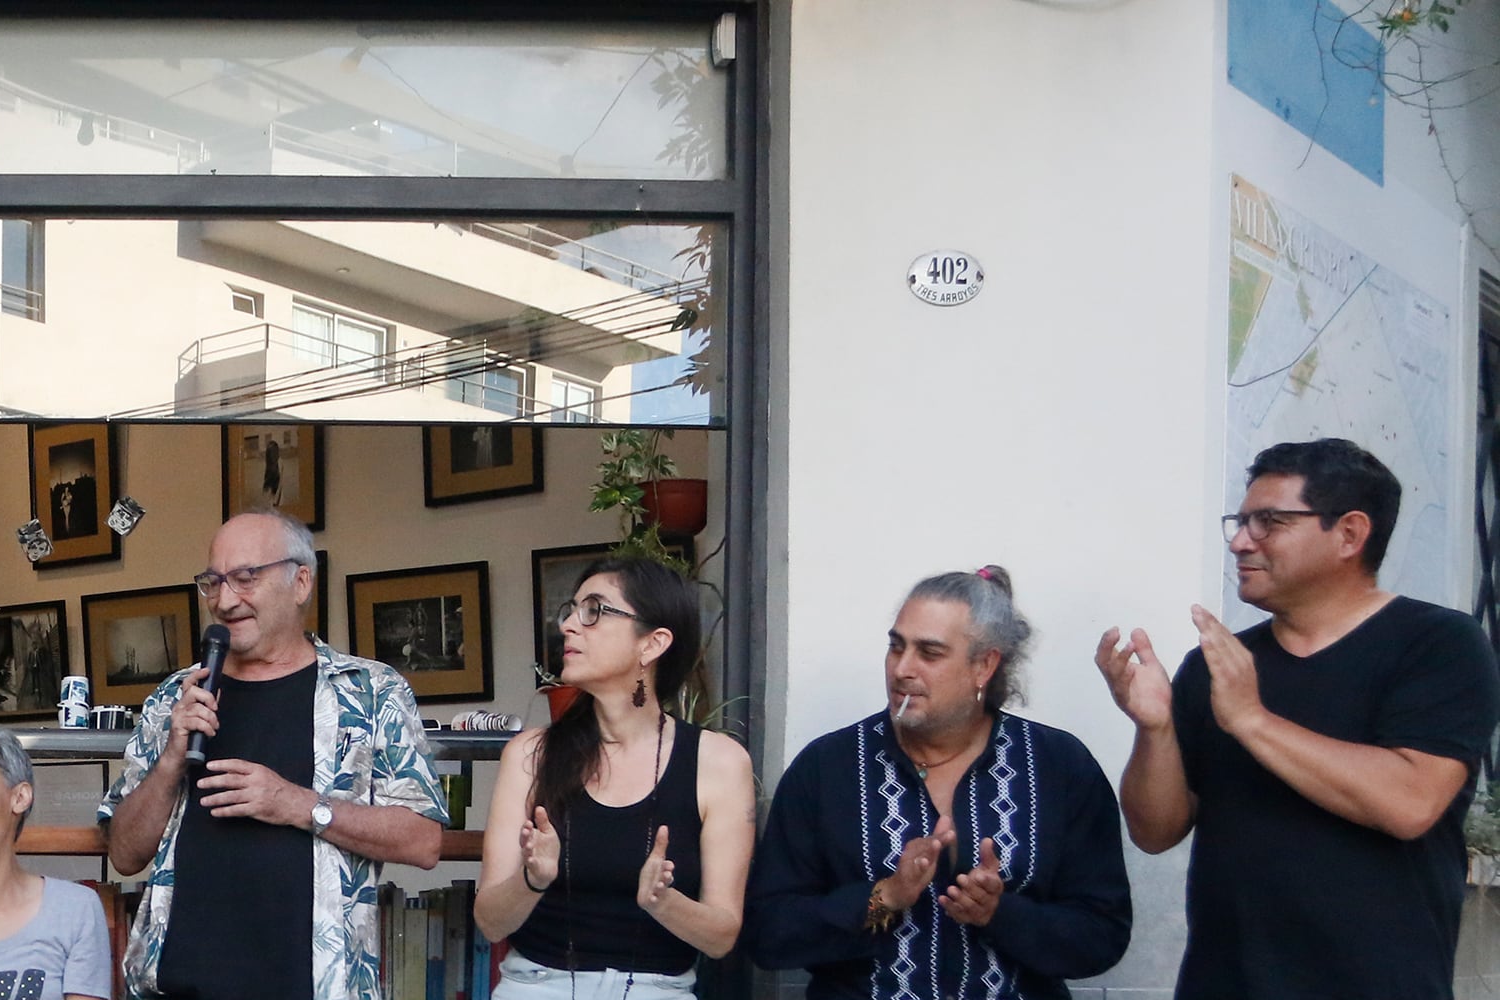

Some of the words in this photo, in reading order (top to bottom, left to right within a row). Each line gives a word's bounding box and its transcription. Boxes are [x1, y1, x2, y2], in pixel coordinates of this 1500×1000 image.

[926, 256, 968, 284] 402
[916, 283, 937, 301] TRES
[939, 283, 979, 303] ARROYOS
